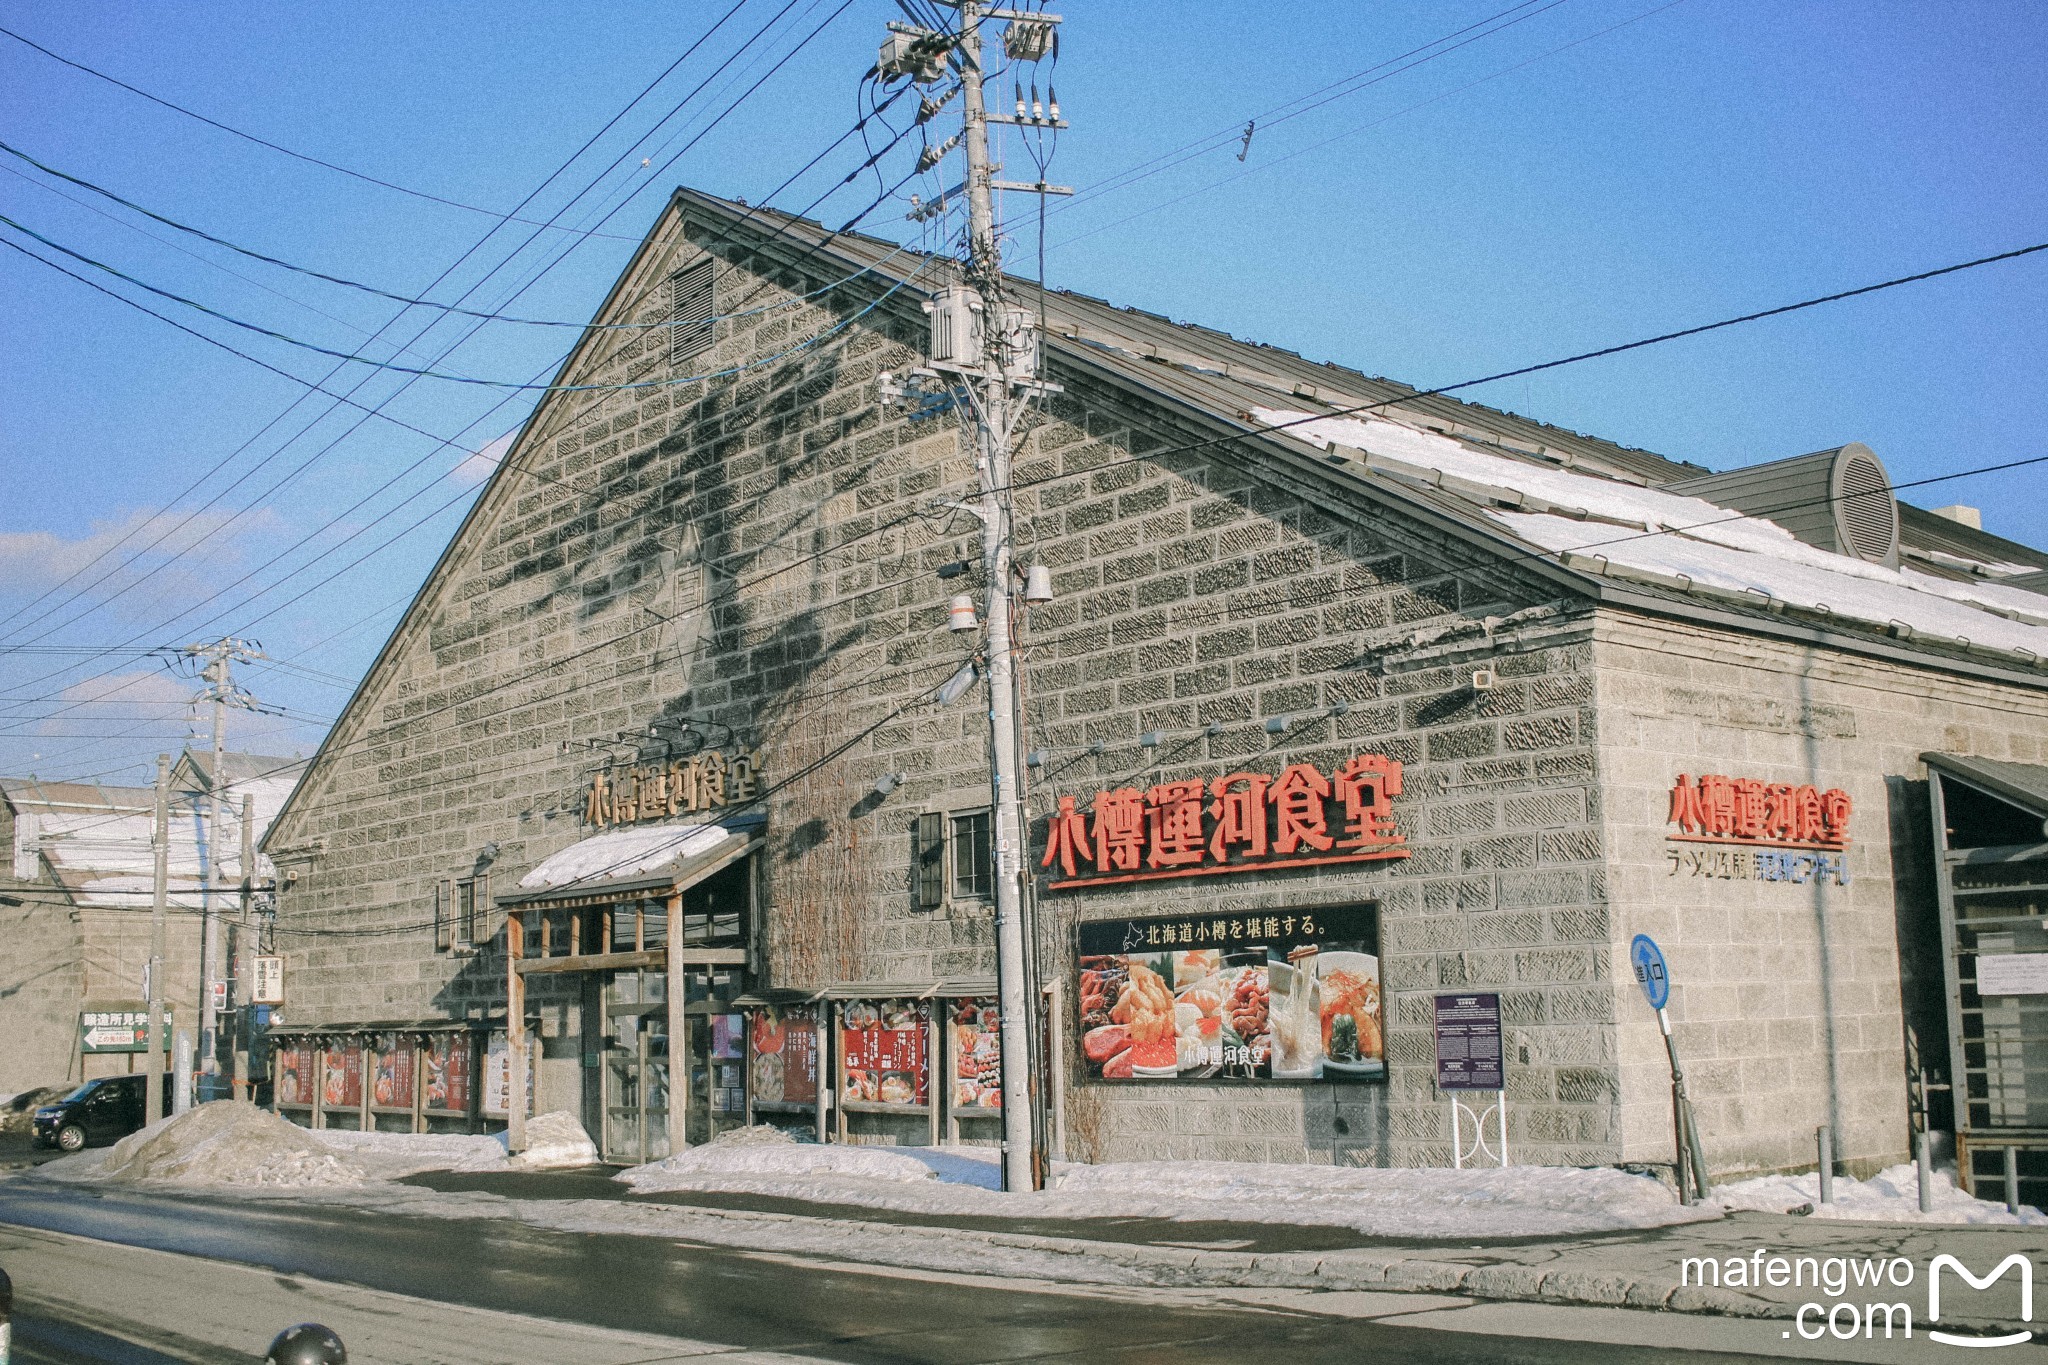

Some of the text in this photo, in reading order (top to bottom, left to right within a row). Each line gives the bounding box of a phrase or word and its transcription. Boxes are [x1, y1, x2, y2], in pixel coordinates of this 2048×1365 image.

[585, 744, 761, 827] 小樽運河食堂
[1669, 773, 1854, 842] 小樽運河食堂
[1041, 754, 1406, 877] 小樽運河食堂
[1147, 915, 1326, 945] 北海道小樽を堪能する。
[258, 960, 267, 999] 落雪注意
[269, 960, 279, 979] 頭上
[808, 1031, 817, 1083] 海鮮丼
[919, 1022, 929, 1092] ラーメン
[1184, 1045, 1265, 1066] 小樽運河食堂
